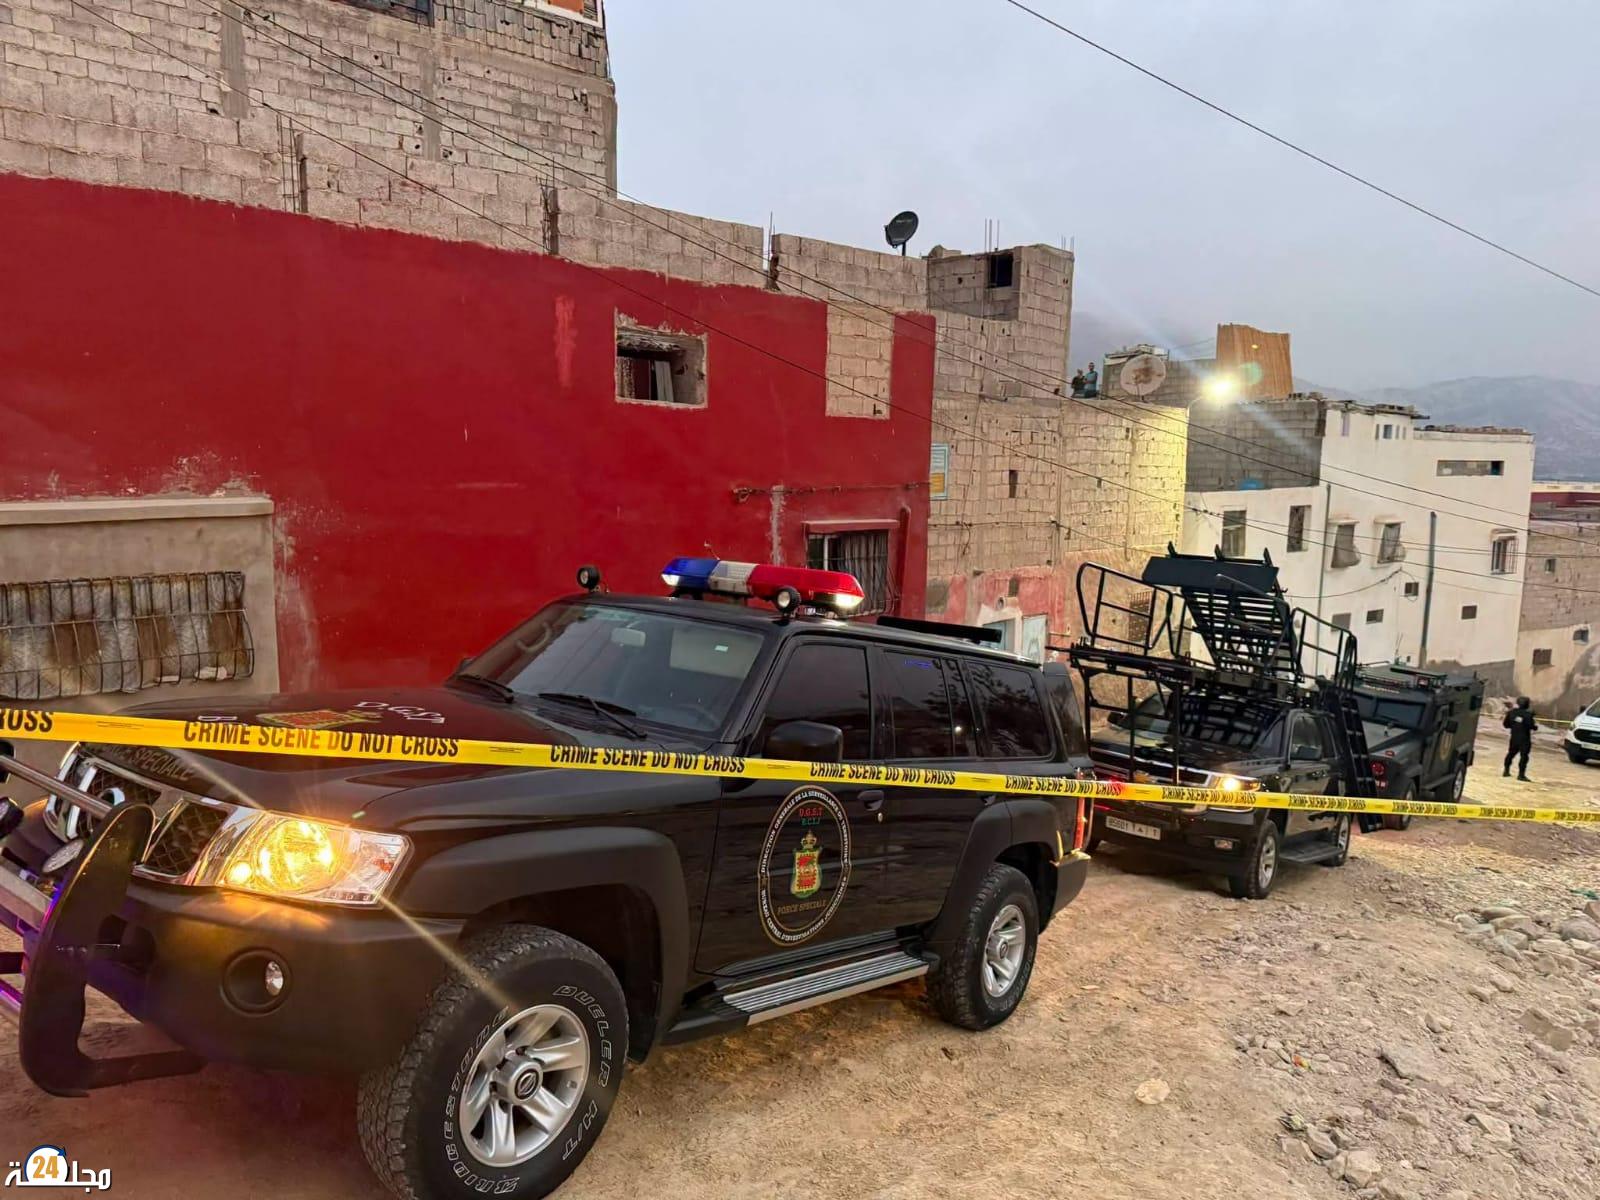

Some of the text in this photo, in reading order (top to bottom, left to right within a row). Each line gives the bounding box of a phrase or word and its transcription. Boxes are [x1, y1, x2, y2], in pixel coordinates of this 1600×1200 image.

[183, 721, 459, 757] CRIME SCENE DO NOT CROSS
[550, 745, 745, 773] CRIME SCENE DO NOT CROSS
[810, 762, 956, 785] CRIME SCENE DO NOT CROSS
[1005, 775, 1121, 796] CRIME SCENE DO NOT CROSS
[552, 985, 612, 1160] DUELER H/T
[444, 1005, 520, 1194] BRIDGESTONE
